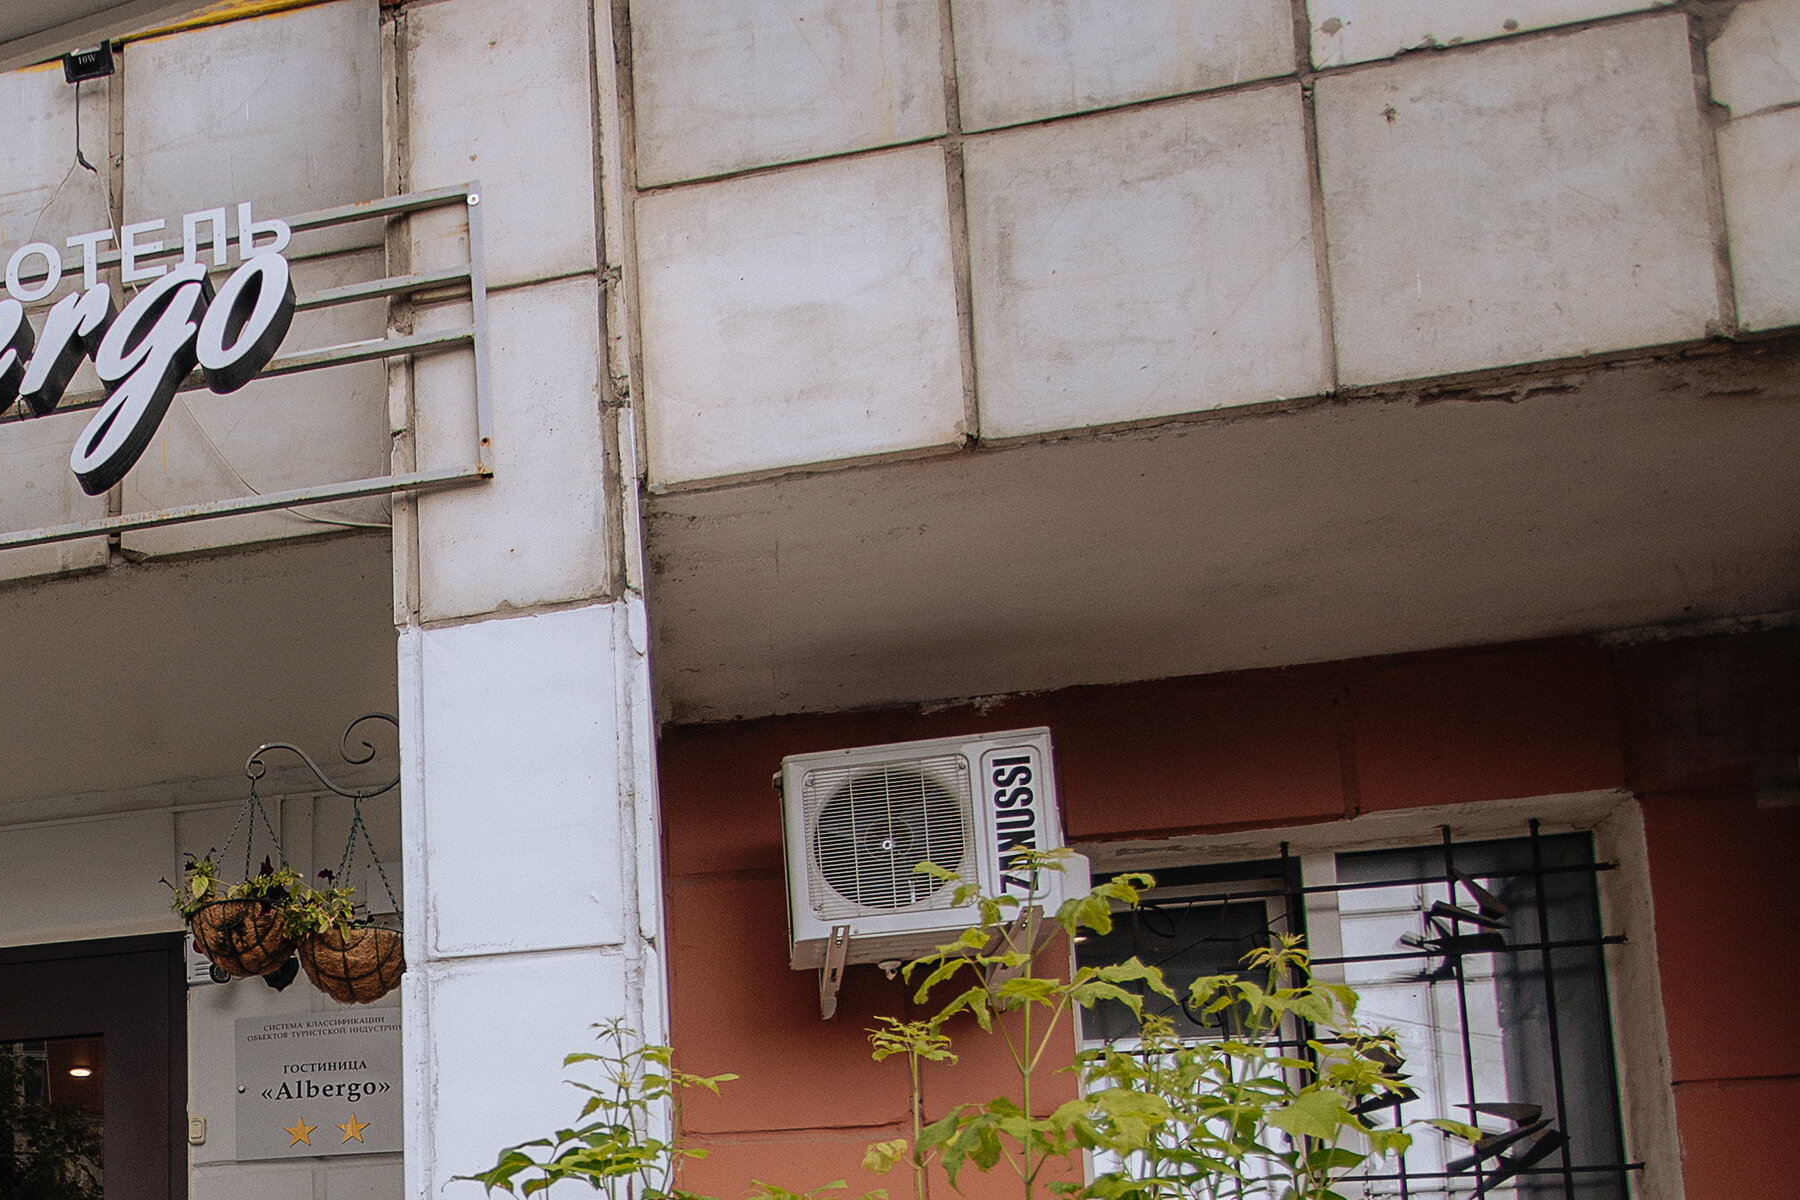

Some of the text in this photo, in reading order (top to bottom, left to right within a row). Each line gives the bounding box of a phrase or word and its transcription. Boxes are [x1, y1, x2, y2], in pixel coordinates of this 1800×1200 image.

[78, 54, 96, 65] 10W
[5, 203, 291, 302] ОТЕЛЬ
[992, 755, 1039, 894] ZANUSSI
[263, 1016, 385, 1032] СИСТЕМА КЛАССИФИКАЦИИ
[283, 1060, 368, 1074] ГОСТИНИЦА
[261, 1080, 391, 1102] «Albergo»
